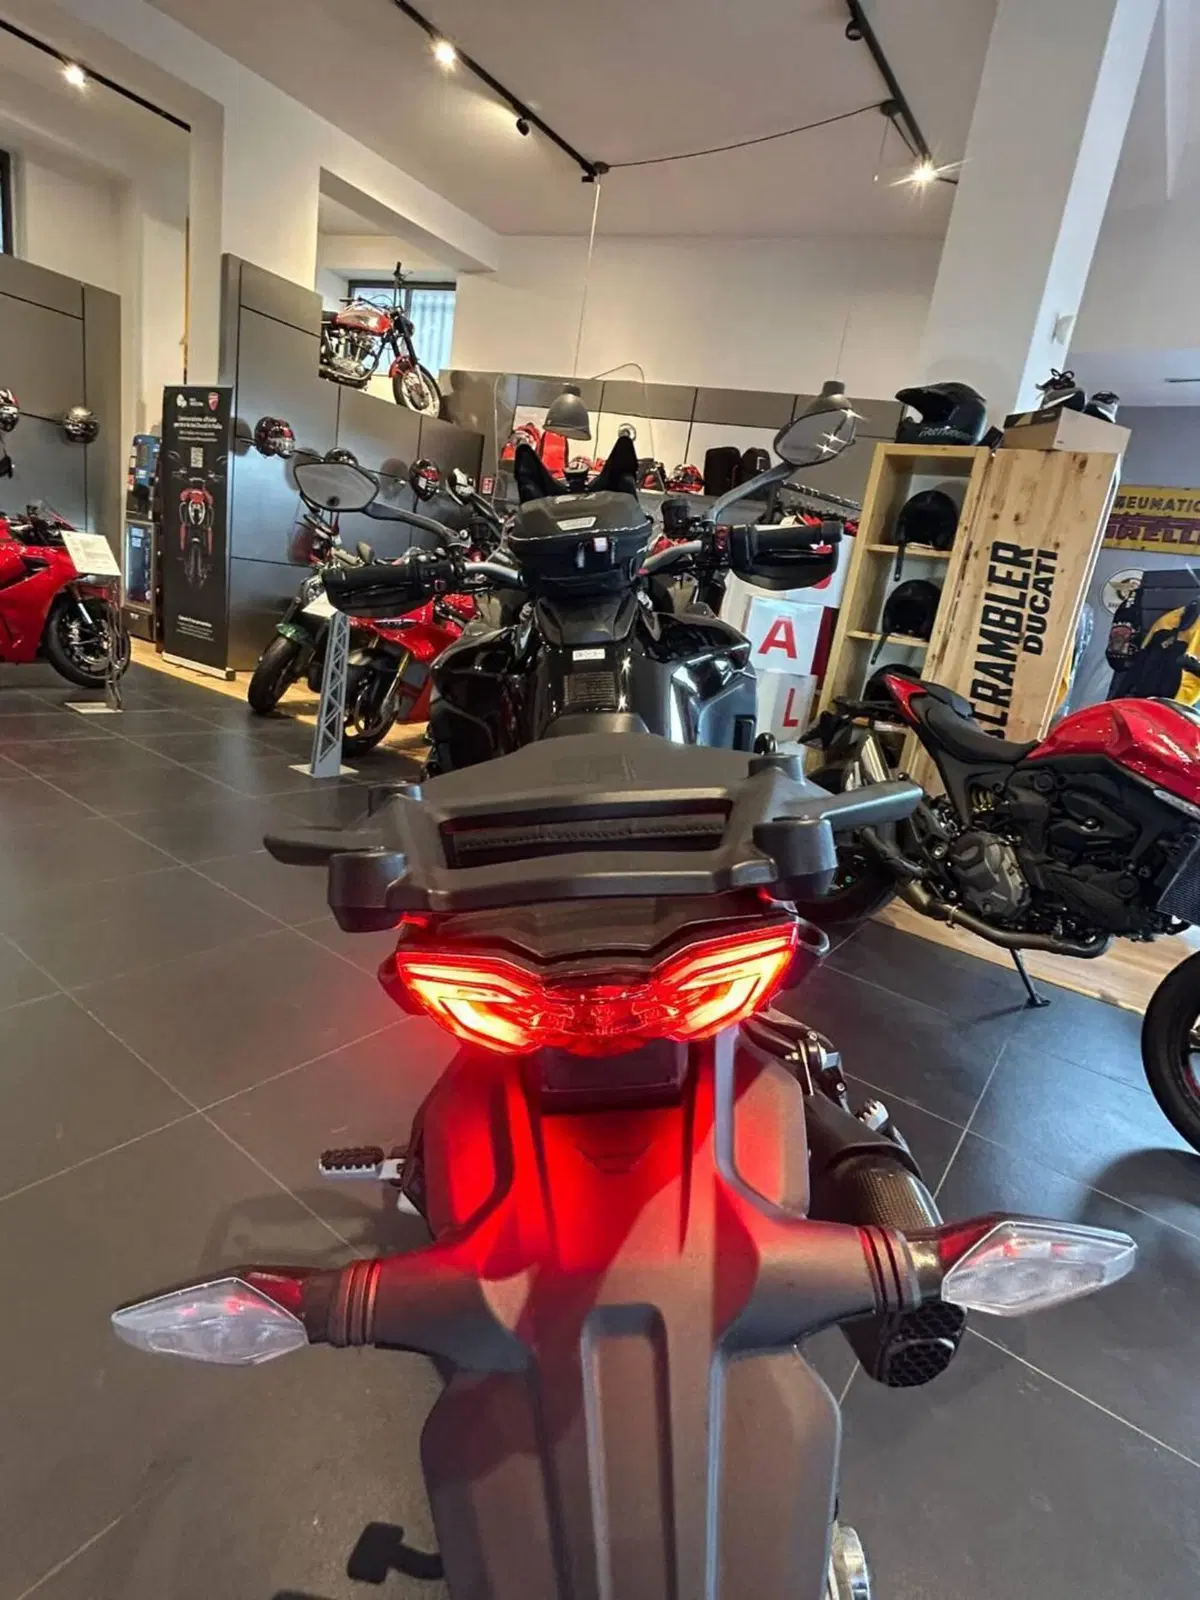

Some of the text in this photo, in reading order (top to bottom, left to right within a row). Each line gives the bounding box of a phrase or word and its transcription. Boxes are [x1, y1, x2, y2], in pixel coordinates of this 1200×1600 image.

[1022, 548, 1059, 656] DUCATI
[757, 615, 798, 660] A
[782, 687, 799, 728] L
